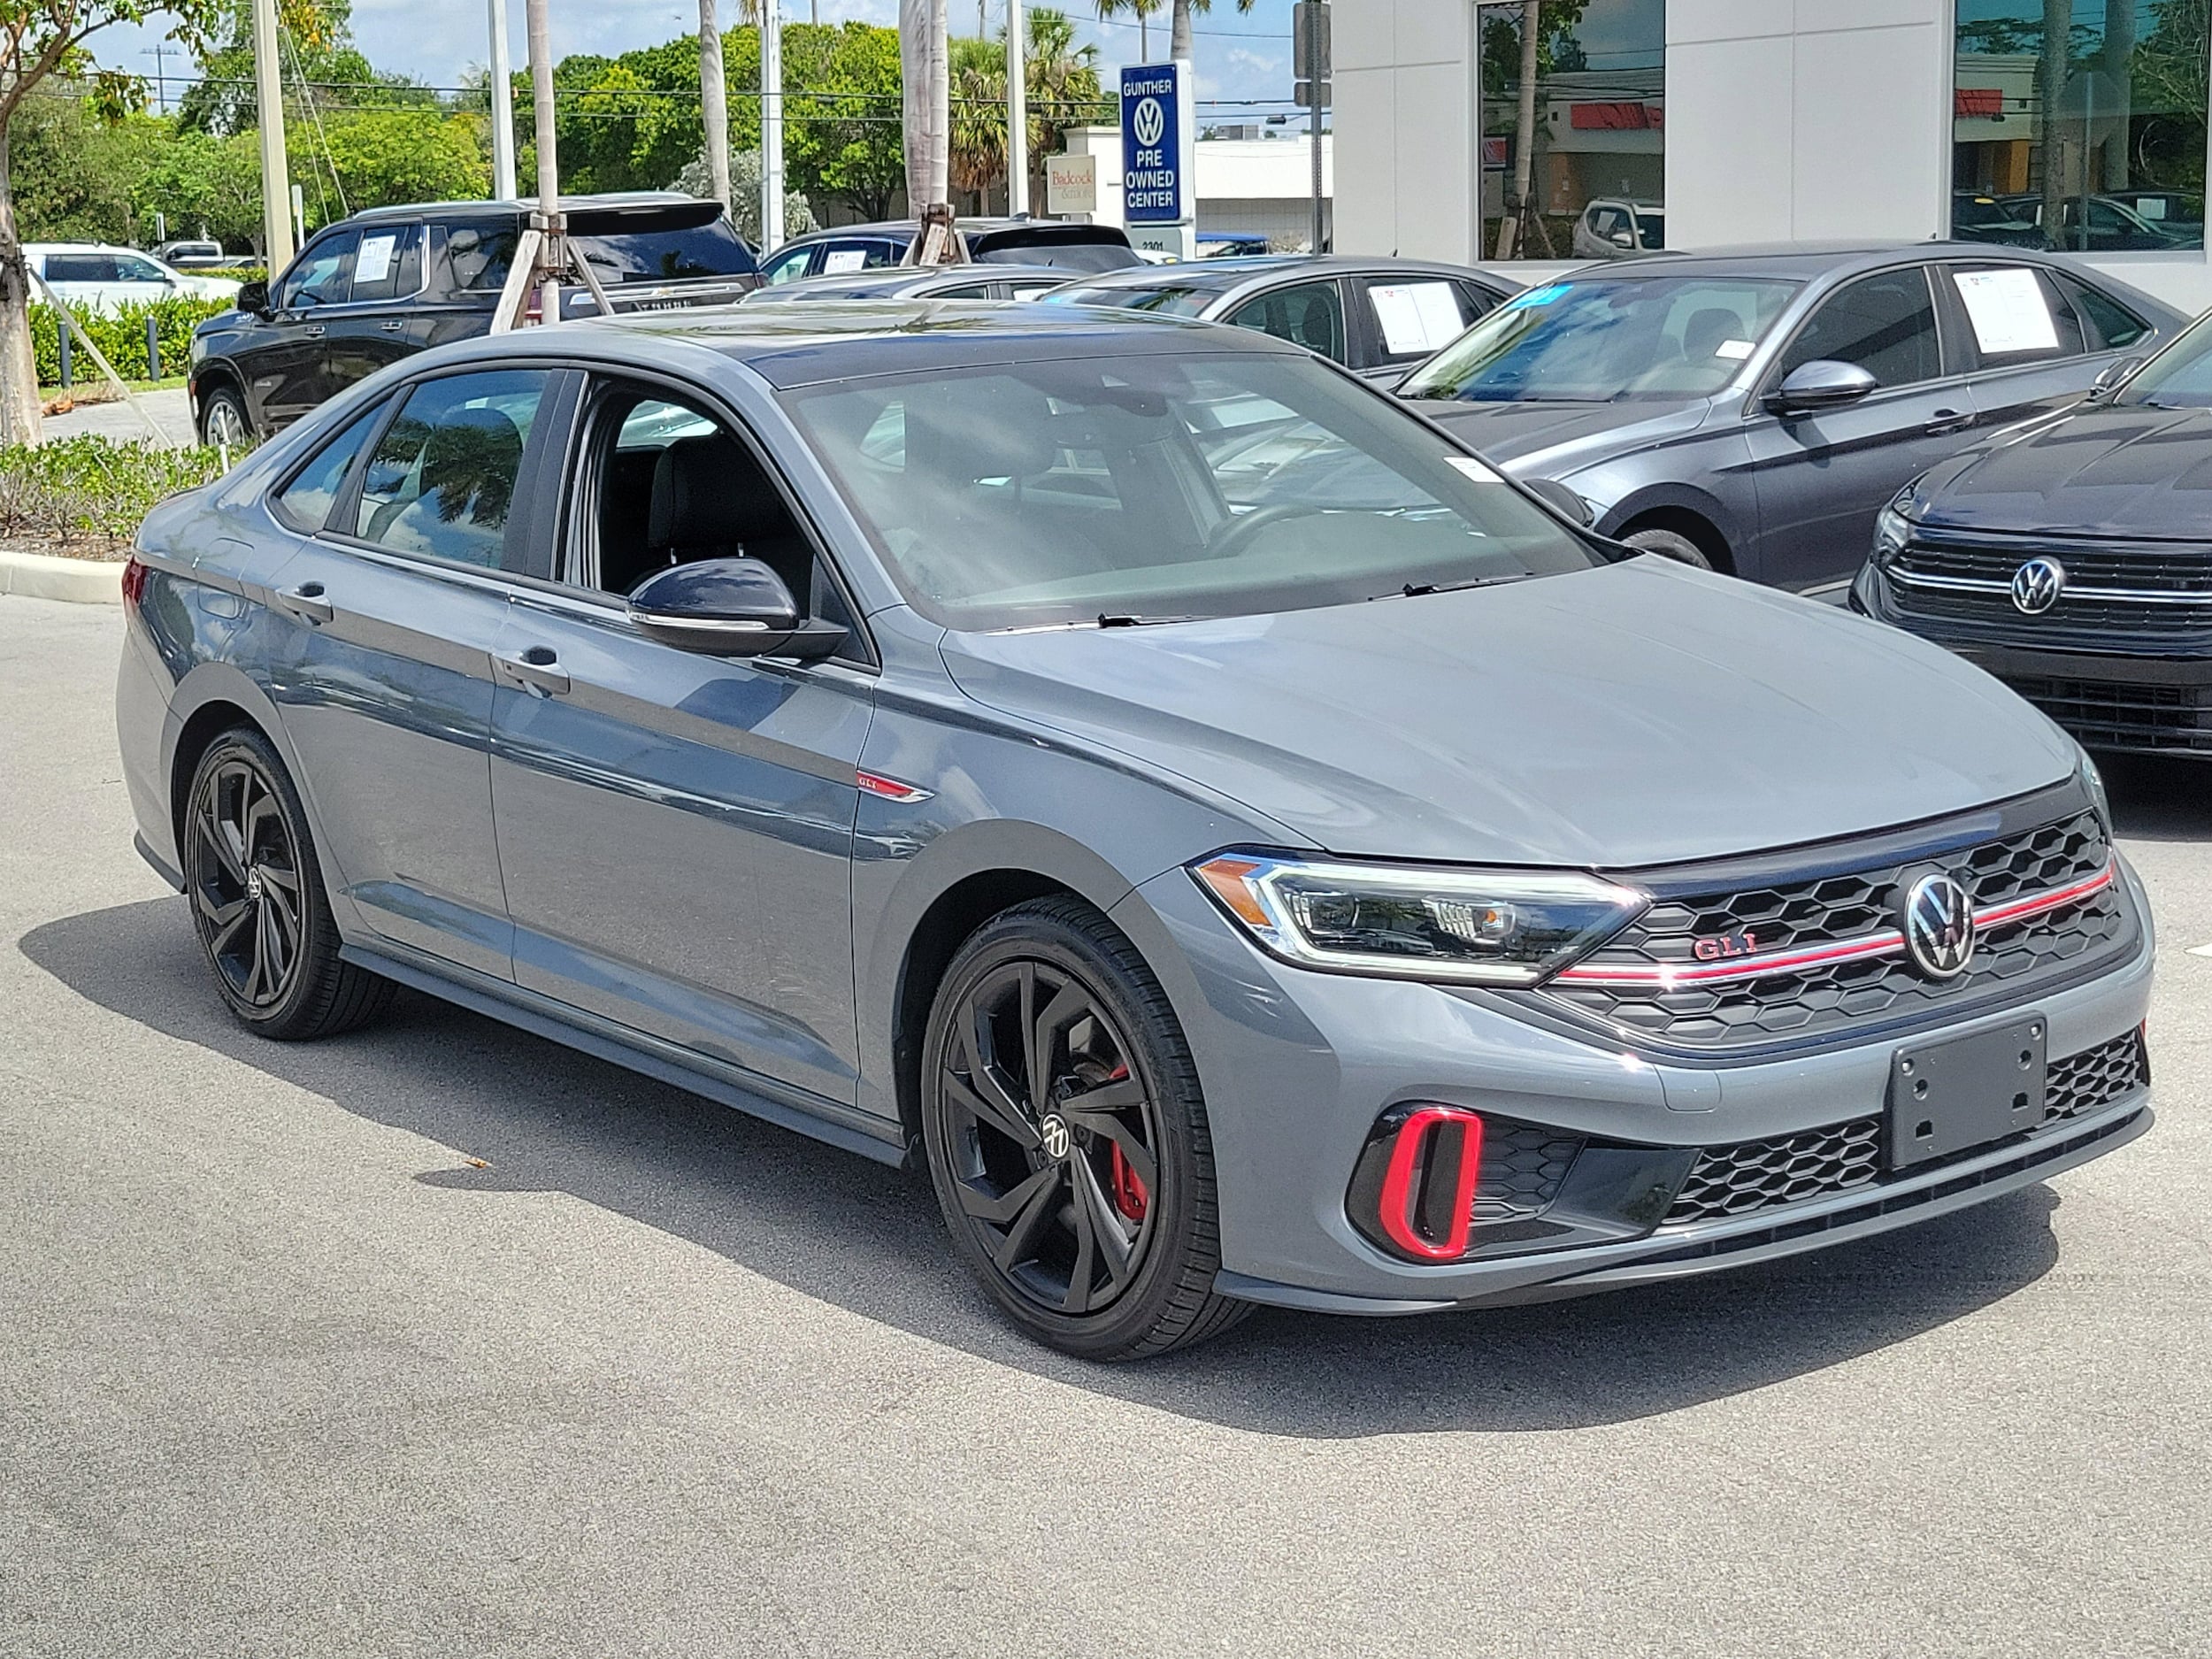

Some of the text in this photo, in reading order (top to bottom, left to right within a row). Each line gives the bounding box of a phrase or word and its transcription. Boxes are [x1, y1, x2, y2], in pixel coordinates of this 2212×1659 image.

[1124, 80, 1171, 96] GUNTHER
[1136, 150, 1163, 167] PRE
[1052, 170, 1092, 186] Badcock
[1125, 170, 1174, 188] OWNED
[1127, 191, 1173, 208] CENTER
[858, 777, 878, 789] GLI
[1694, 933, 1757, 960] GLI
